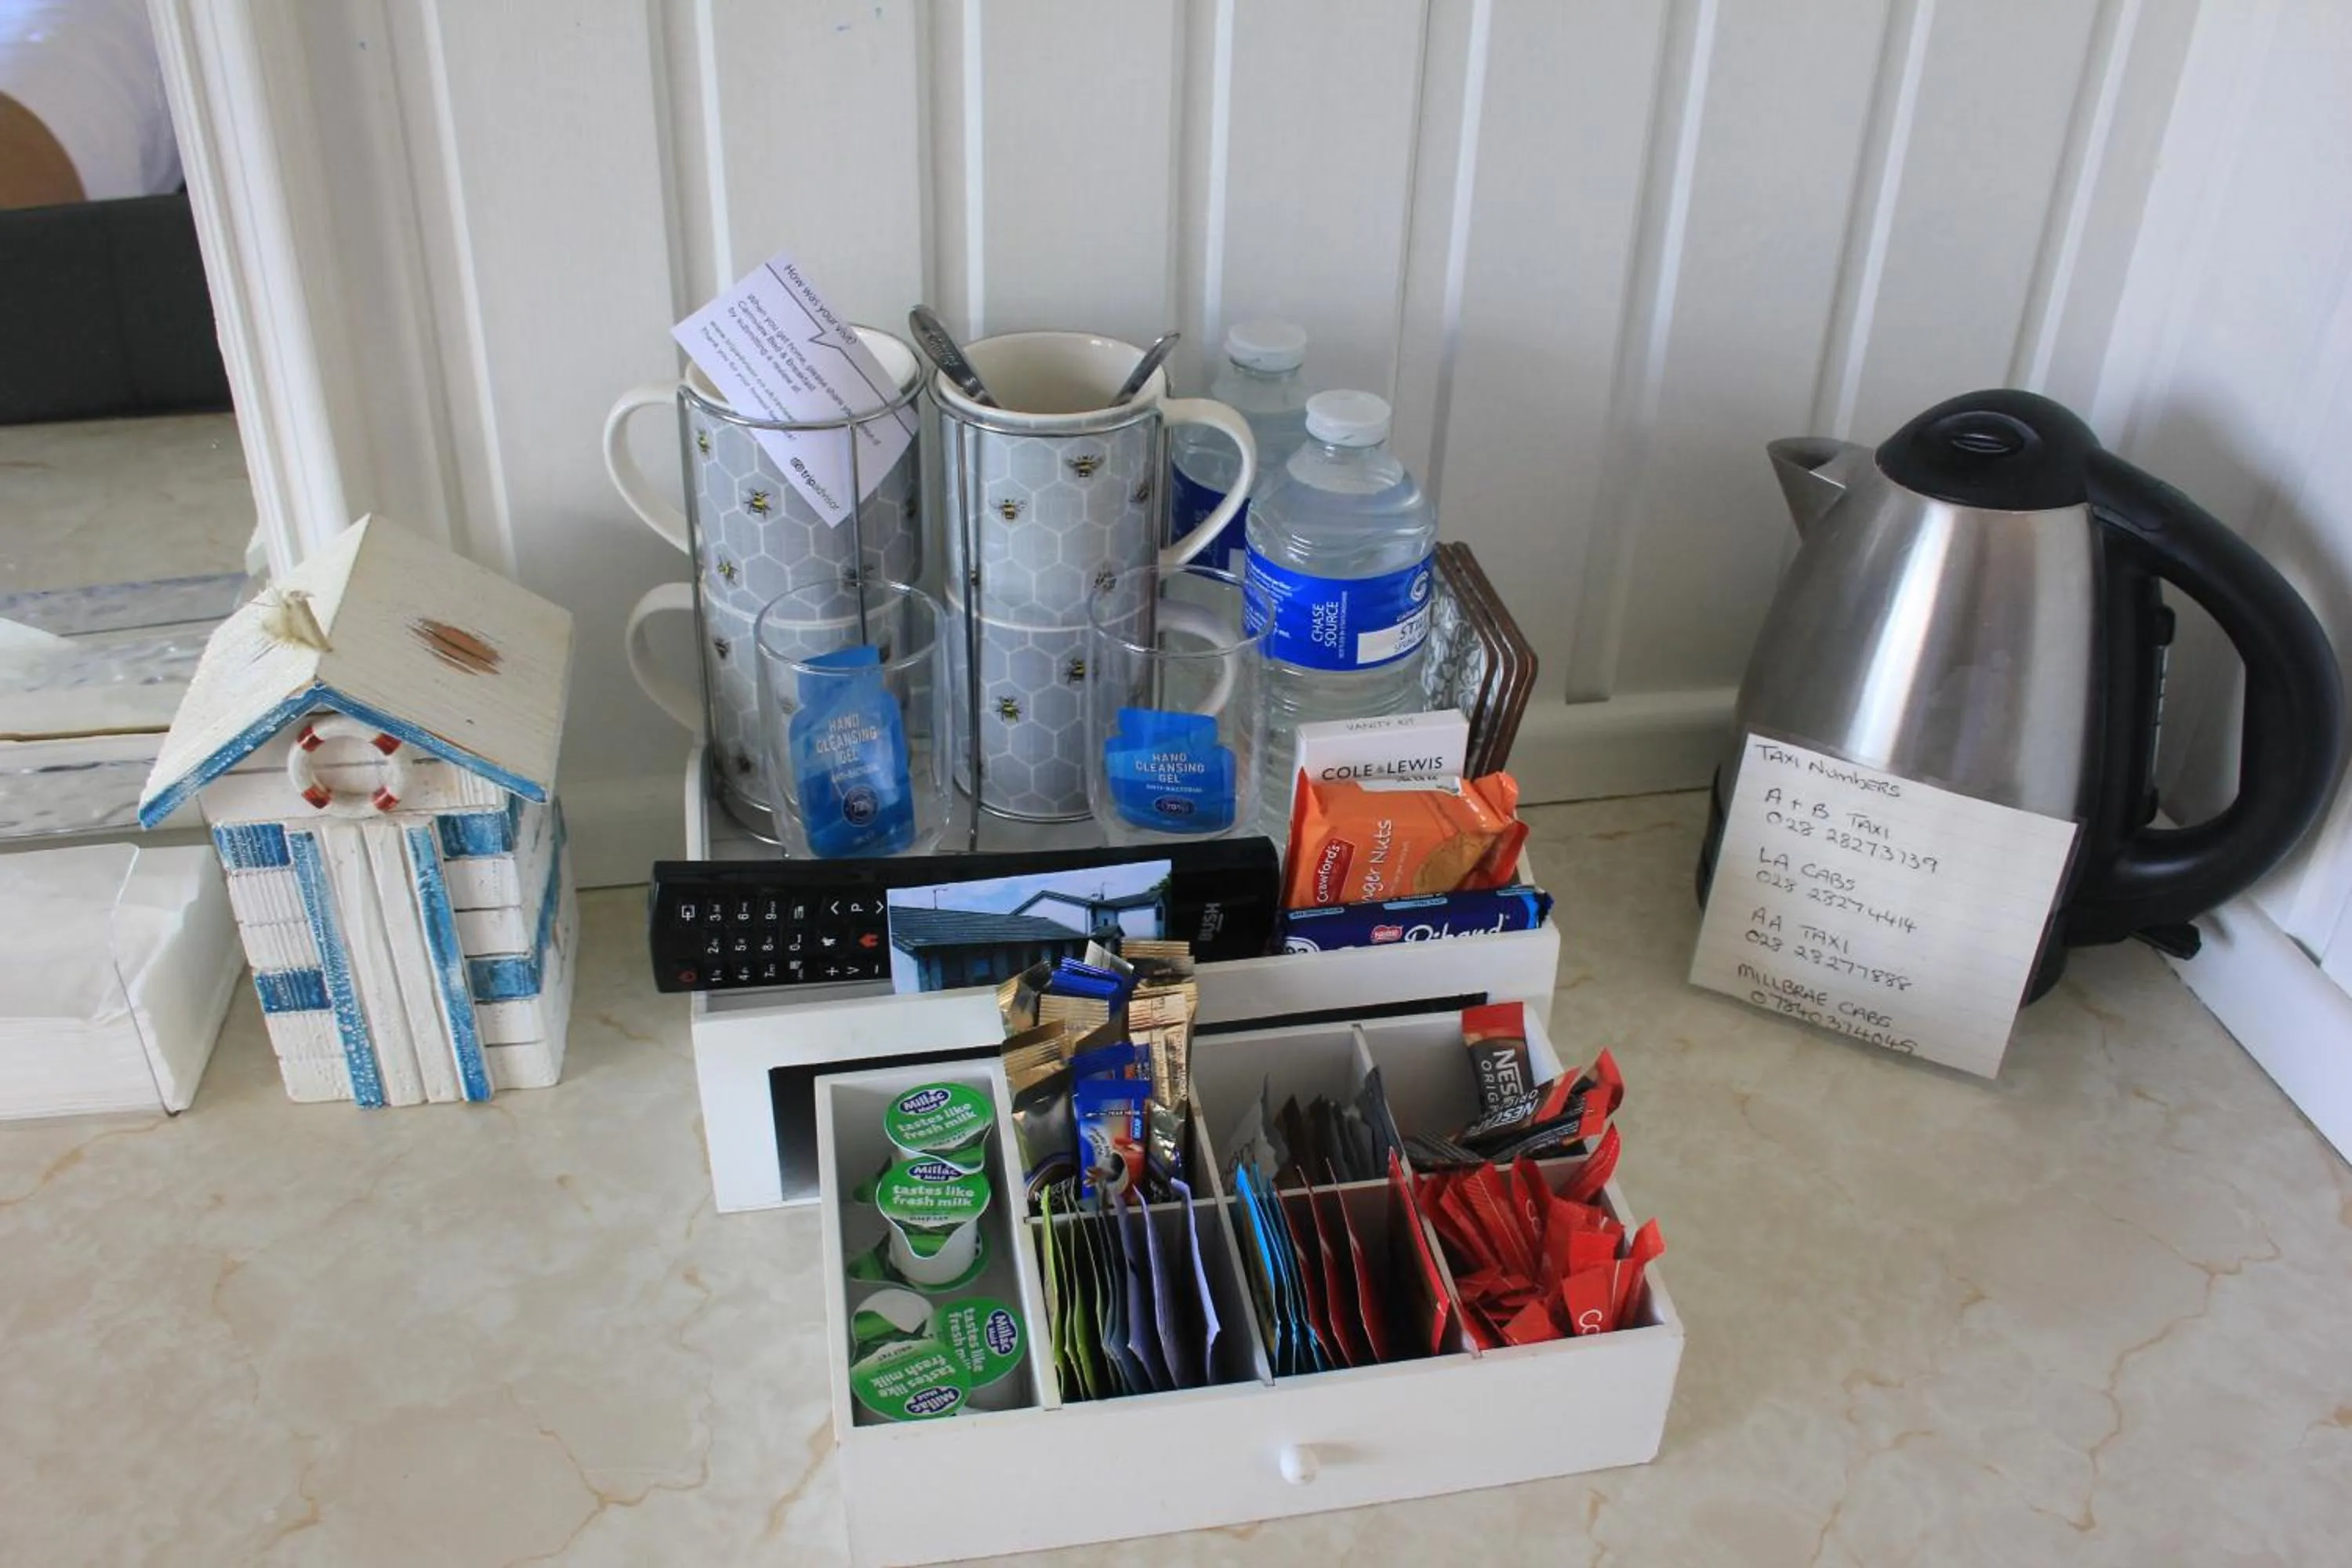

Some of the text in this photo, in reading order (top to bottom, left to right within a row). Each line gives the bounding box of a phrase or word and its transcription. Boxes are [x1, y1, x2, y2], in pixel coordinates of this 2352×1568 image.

[782, 263, 806, 288] How
[801, 285, 820, 306] was
[815, 303, 839, 328] your
[746, 292, 768, 318] When
[764, 315, 779, 332] you
[775, 328, 790, 345] get
[1311, 603, 1324, 644] CHASE
[1325, 601, 1339, 648] SOURCE
[829, 713, 859, 731] HAND
[1347, 721, 1390, 731] VANITY
[816, 726, 878, 753] CLEANSING
[1135, 762, 1205, 773] CLEANSING
[1152, 753, 1187, 762] HAND
[1322, 764, 1372, 780] COLE
[1387, 757, 1443, 774] LEWIS
[1755, 743, 1799, 768] TAXI
[1159, 775, 1180, 783] GEL
[1764, 787, 1782, 804] A
[1811, 803, 1830, 819] B
[1846, 811, 1890, 839] TAXI
[1766, 811, 1814, 837] 028
[1373, 818, 1392, 863] Nuts
[1316, 844, 1341, 903] Crawford's
[1755, 869, 1796, 893] 028
[1759, 847, 1857, 891] LA CABS
[851, 903, 863, 912] P
[1198, 903, 1221, 941] BUSH
[1745, 929, 1783, 953] 028
[1799, 923, 1849, 954] TAXI
[1737, 963, 1894, 1029] MILLBRAE CABS
[903, 1091, 945, 1111] Millac
[897, 1103, 972, 1131] tastes like
[903, 1123, 943, 1139] fresh
[946, 1111, 977, 1128] milk
[914, 1164, 958, 1175] Millac
[893, 1185, 975, 1197] tastes like
[893, 1196, 972, 1207] fresh milk
[948, 1312, 967, 1345] fresh
[964, 1308, 986, 1372] tastes like
[995, 1315, 1011, 1354] Millac
[871, 1355, 947, 1388] fresh milk
[878, 1364, 956, 1398] tastes like
[910, 1391, 956, 1412] Millac
